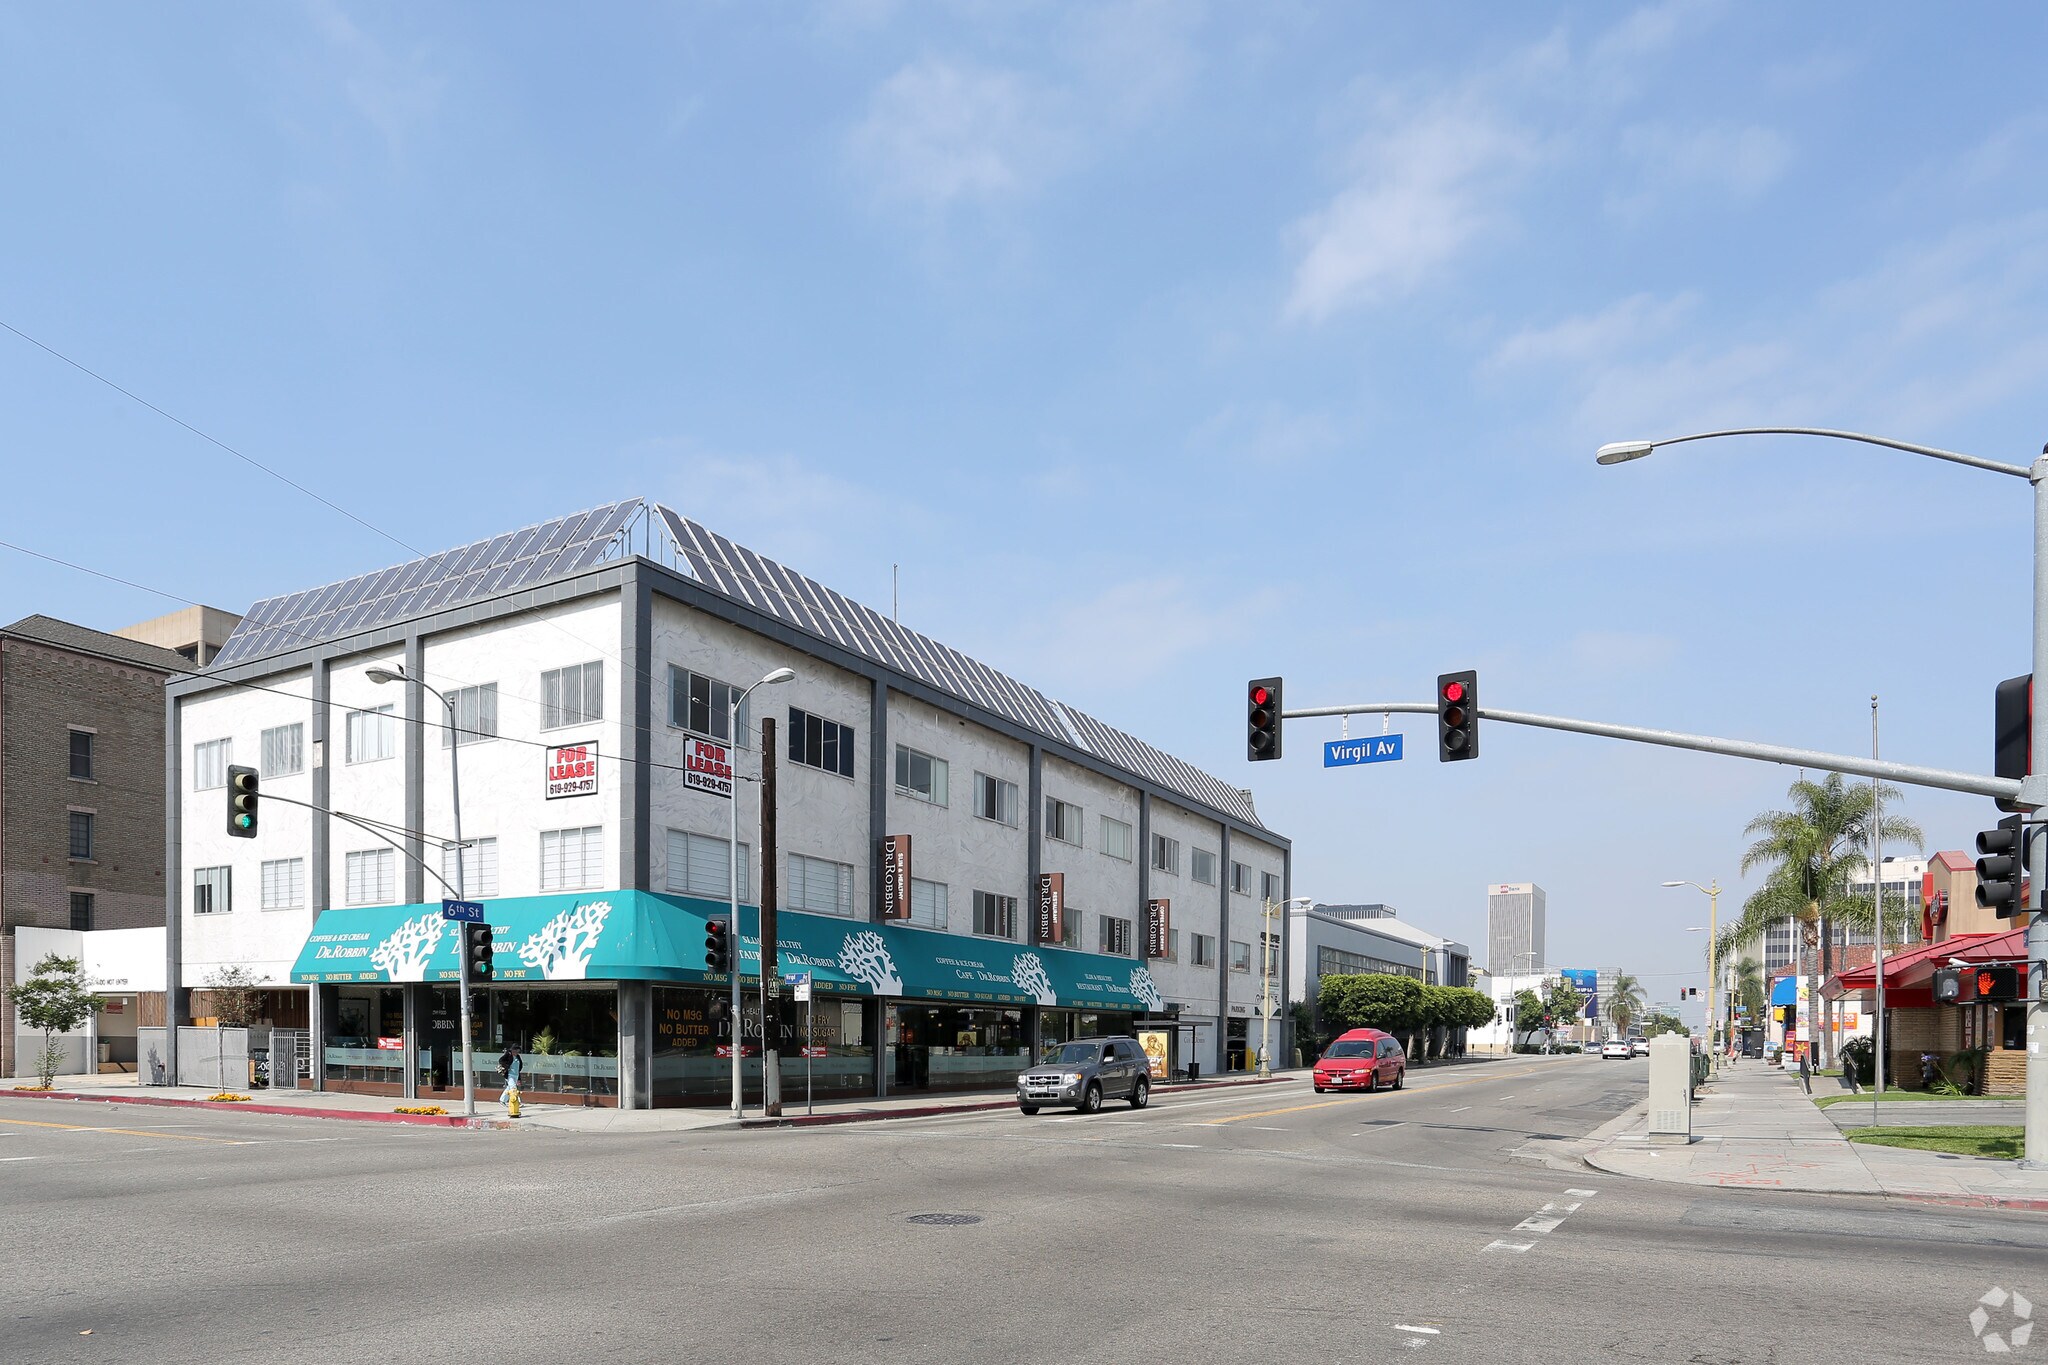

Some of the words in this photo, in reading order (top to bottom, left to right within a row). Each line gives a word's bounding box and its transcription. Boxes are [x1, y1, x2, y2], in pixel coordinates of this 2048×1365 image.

[556, 746, 587, 763] FOR
[695, 740, 726, 762] FOR
[1331, 744, 1370, 762] Virgil
[1376, 740, 1396, 755] Av
[549, 761, 595, 781] LEASE
[687, 754, 732, 780] LEASE
[550, 779, 594, 795] 619-929-4757
[688, 772, 732, 793] 619-929-4757
[448, 904, 465, 917] 6th
[468, 907, 480, 918] St
[348, 932, 370, 941] CREAM
[326, 973, 333, 981] NO
[333, 973, 352, 981] BUTTER
[359, 972, 378, 980] ADDED
[439, 971, 448, 979] NO
[514, 969, 526, 977] FRY
[703, 972, 713, 981] NO
[714, 973, 728, 982] MSG
[814, 981, 834, 990] ADDED
[839, 983, 848, 991] NO
[667, 1008, 680, 1021] NO
[683, 1009, 703, 1021] MSG
[659, 1023, 672, 1035] NO
[675, 1023, 709, 1036] BUTTER
[813, 1028, 836, 1038] SUGAR
[672, 1037, 697, 1047] ADDED
